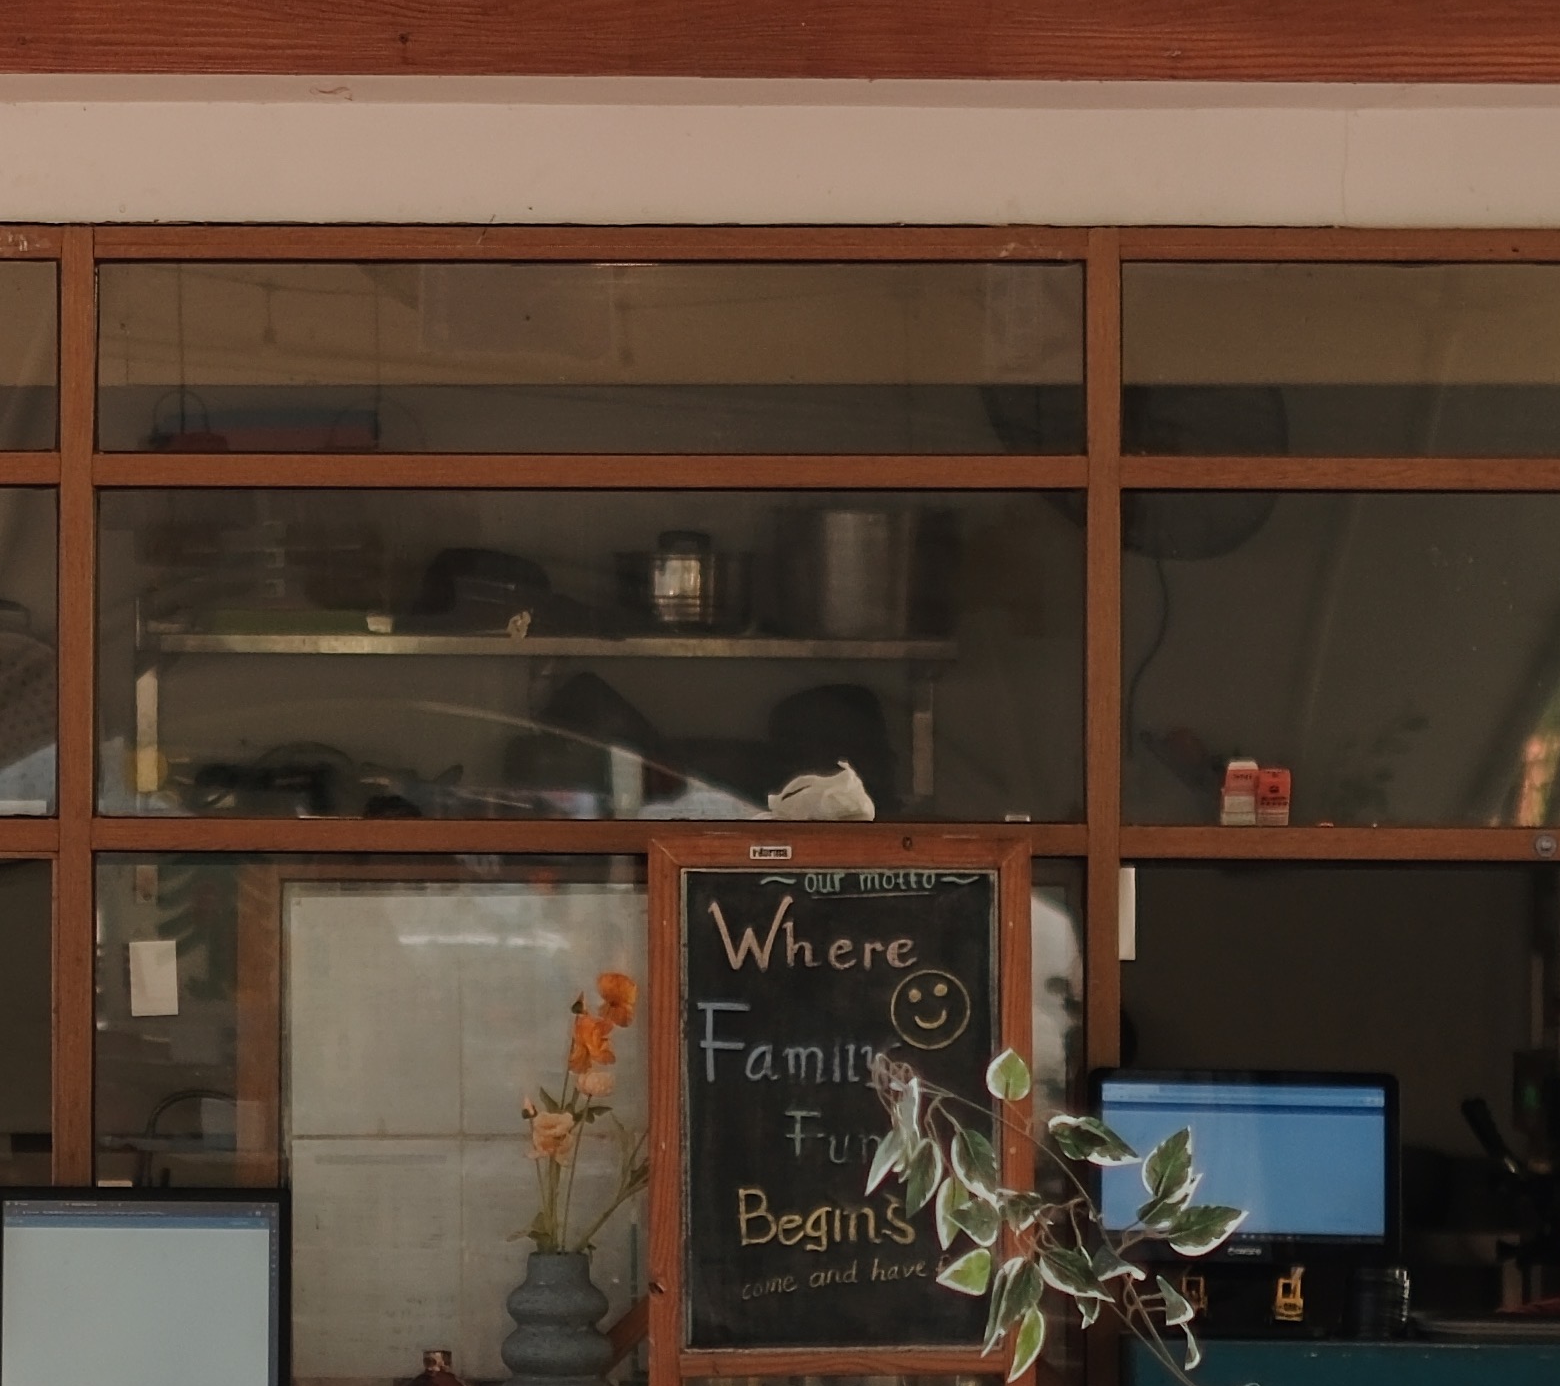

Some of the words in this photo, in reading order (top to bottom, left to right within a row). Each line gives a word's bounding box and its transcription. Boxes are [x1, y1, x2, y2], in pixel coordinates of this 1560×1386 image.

[707, 895, 918, 973] Where
[737, 1187, 917, 1252] Begins
[741, 1274, 798, 1301] come
[808, 1259, 858, 1288] and
[870, 1257, 928, 1282] have
